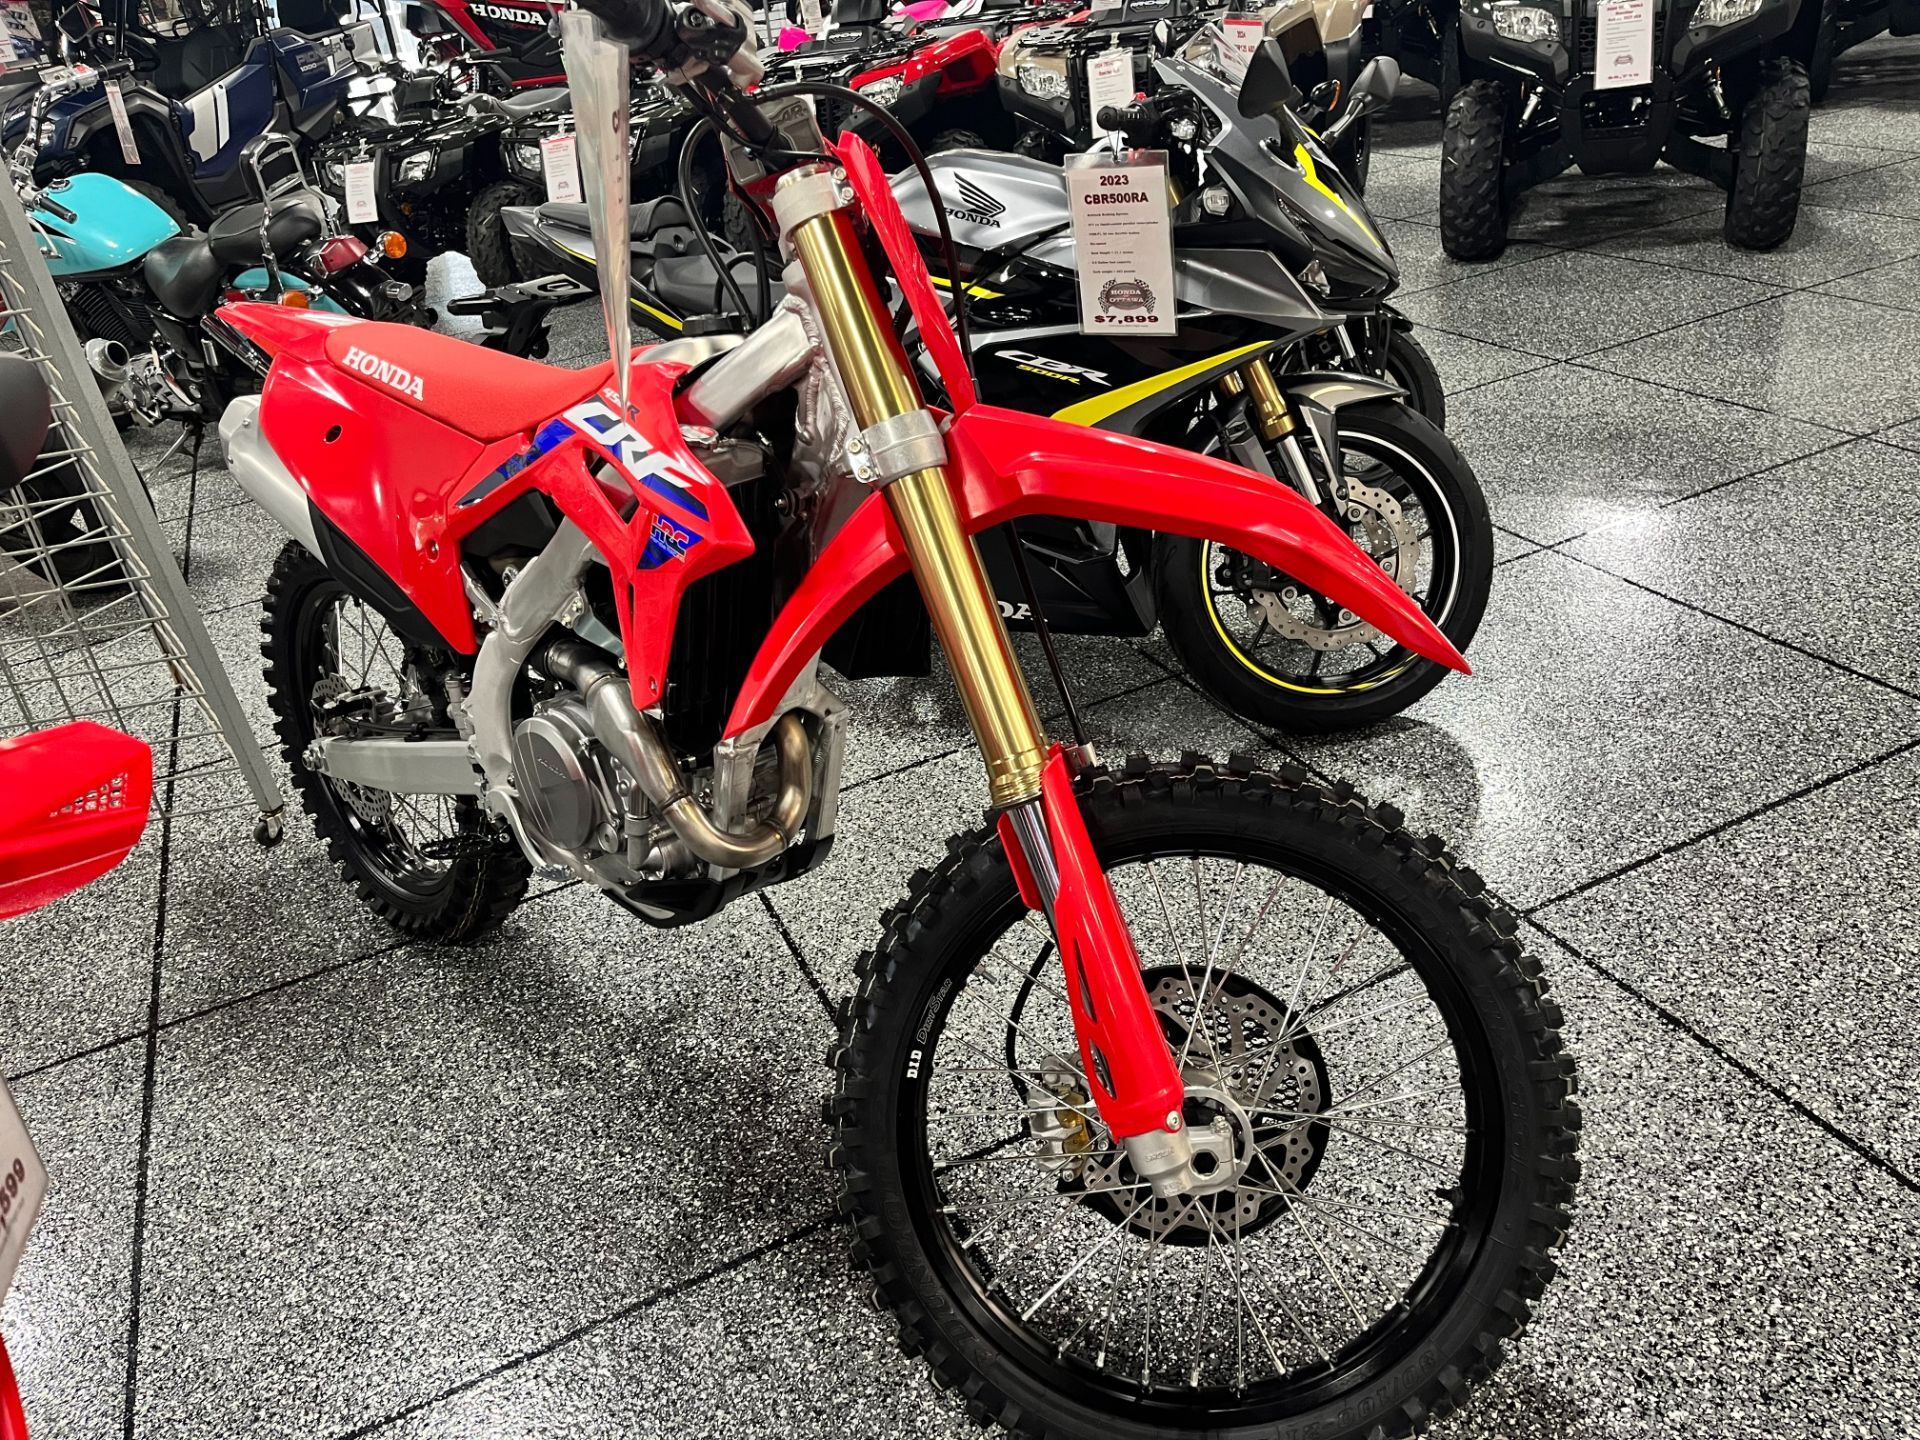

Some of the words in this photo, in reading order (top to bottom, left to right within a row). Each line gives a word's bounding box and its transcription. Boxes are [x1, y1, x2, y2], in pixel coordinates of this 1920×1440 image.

[469, 4, 547, 26] HONDA
[1099, 174, 1129, 186] 2023
[1084, 191, 1149, 205] CBR500RA
[943, 207, 1001, 228] HONDA
[1094, 315, 1159, 324] $7,899
[342, 345, 424, 401] HONDA
[994, 350, 1112, 387] CBR
[1016, 364, 1080, 385] 500R
[562, 402, 709, 488] CRF
[651, 512, 690, 557] HRC
